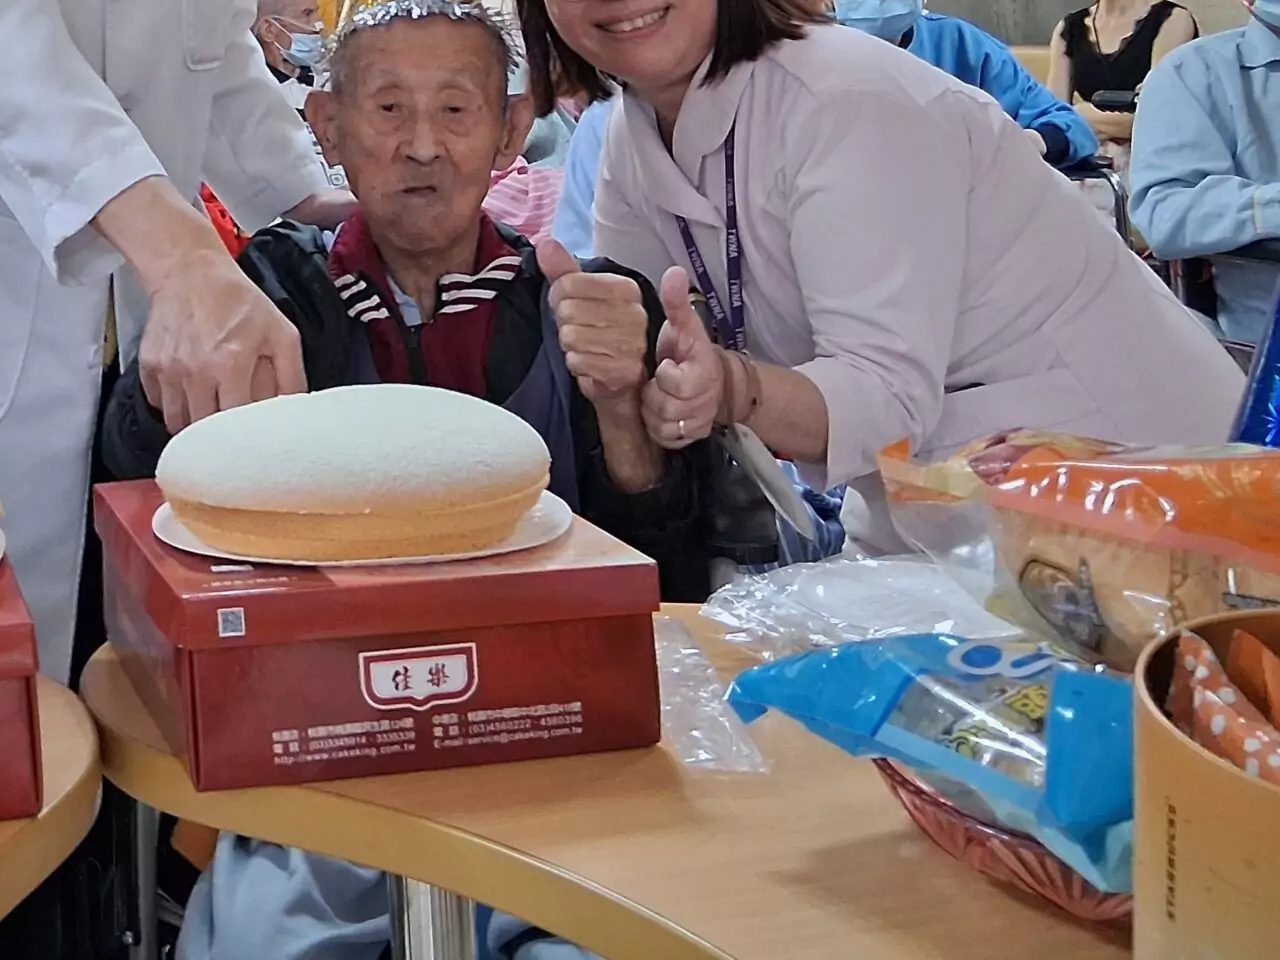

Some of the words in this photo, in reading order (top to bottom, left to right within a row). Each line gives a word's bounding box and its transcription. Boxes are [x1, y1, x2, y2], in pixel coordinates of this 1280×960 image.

[727, 229, 738, 258] TWNA
[706, 291, 725, 320] TWNA
[730, 280, 742, 308] TWNA
